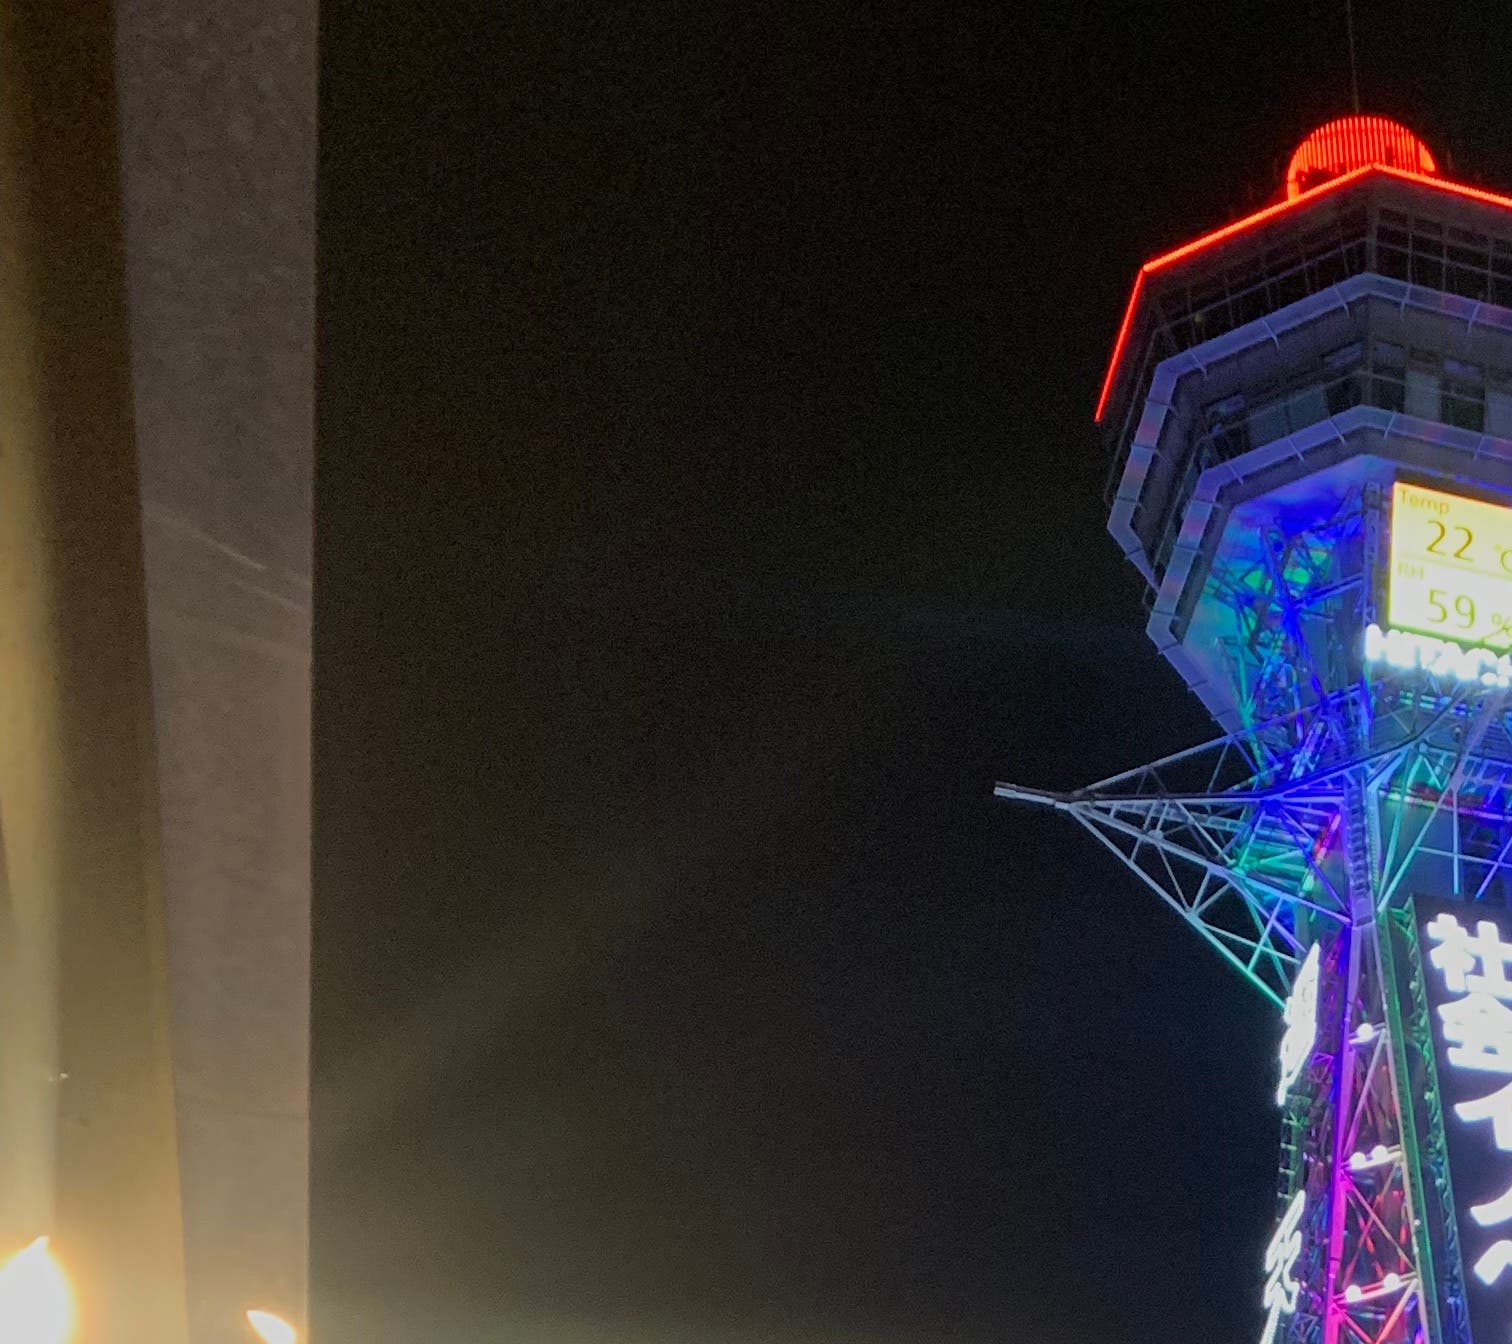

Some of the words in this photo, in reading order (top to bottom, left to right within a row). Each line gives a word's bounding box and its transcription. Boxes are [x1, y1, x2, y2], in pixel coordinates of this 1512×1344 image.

[1399, 489, 1450, 516] Temp
[1425, 519, 1475, 563] 22
[1397, 561, 1425, 580] RH
[1425, 588, 1477, 630] 59
